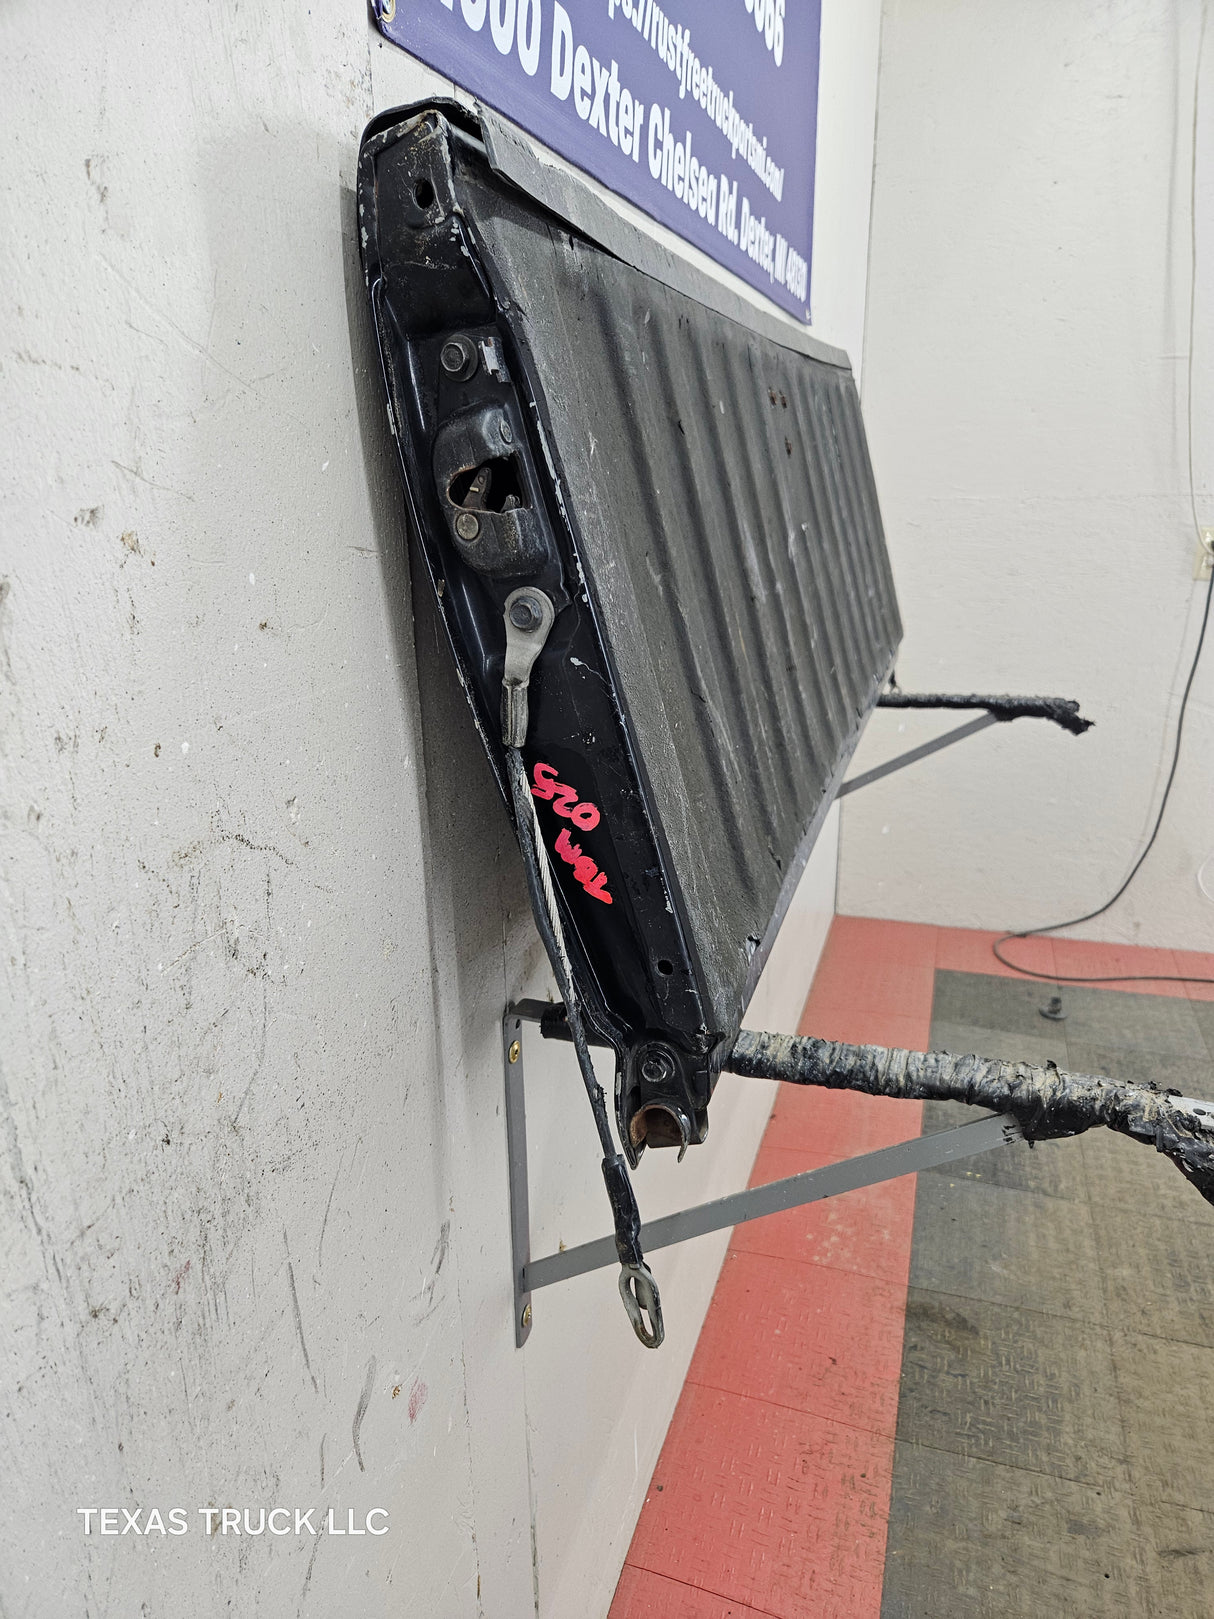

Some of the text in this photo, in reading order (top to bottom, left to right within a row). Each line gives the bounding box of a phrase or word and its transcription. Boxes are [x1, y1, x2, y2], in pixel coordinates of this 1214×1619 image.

[744, 0, 785, 67] 66
[440, 0, 541, 76] 00
[551, 0, 645, 163] Dexter
[648, 103, 718, 226] Chelsea
[718, 173, 738, 246] Rd.
[739, 196, 775, 284] Dexter,
